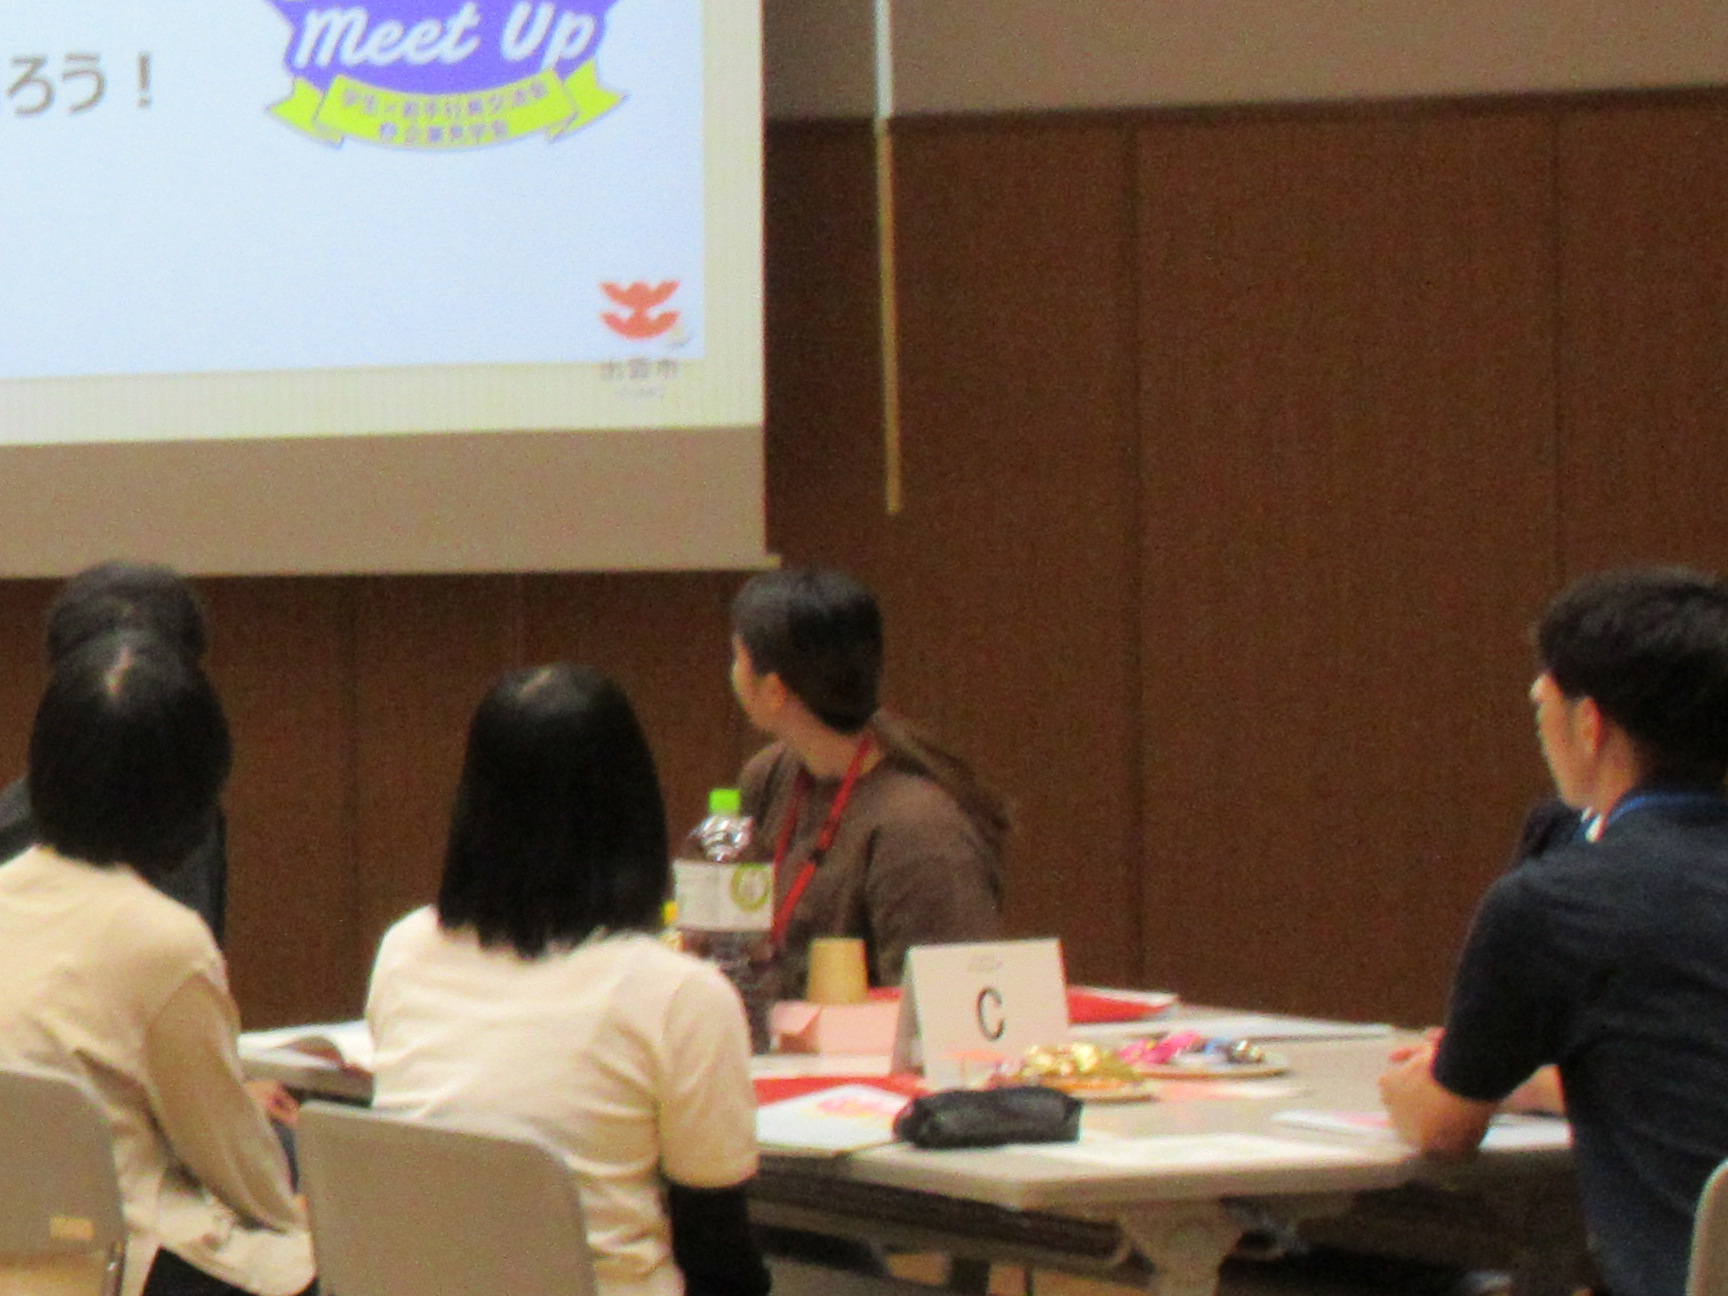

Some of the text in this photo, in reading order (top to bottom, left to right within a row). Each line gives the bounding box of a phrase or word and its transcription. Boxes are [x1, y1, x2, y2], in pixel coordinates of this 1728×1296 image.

[295, 1, 597, 73] Meet Up
[977, 988, 1004, 1040] C
